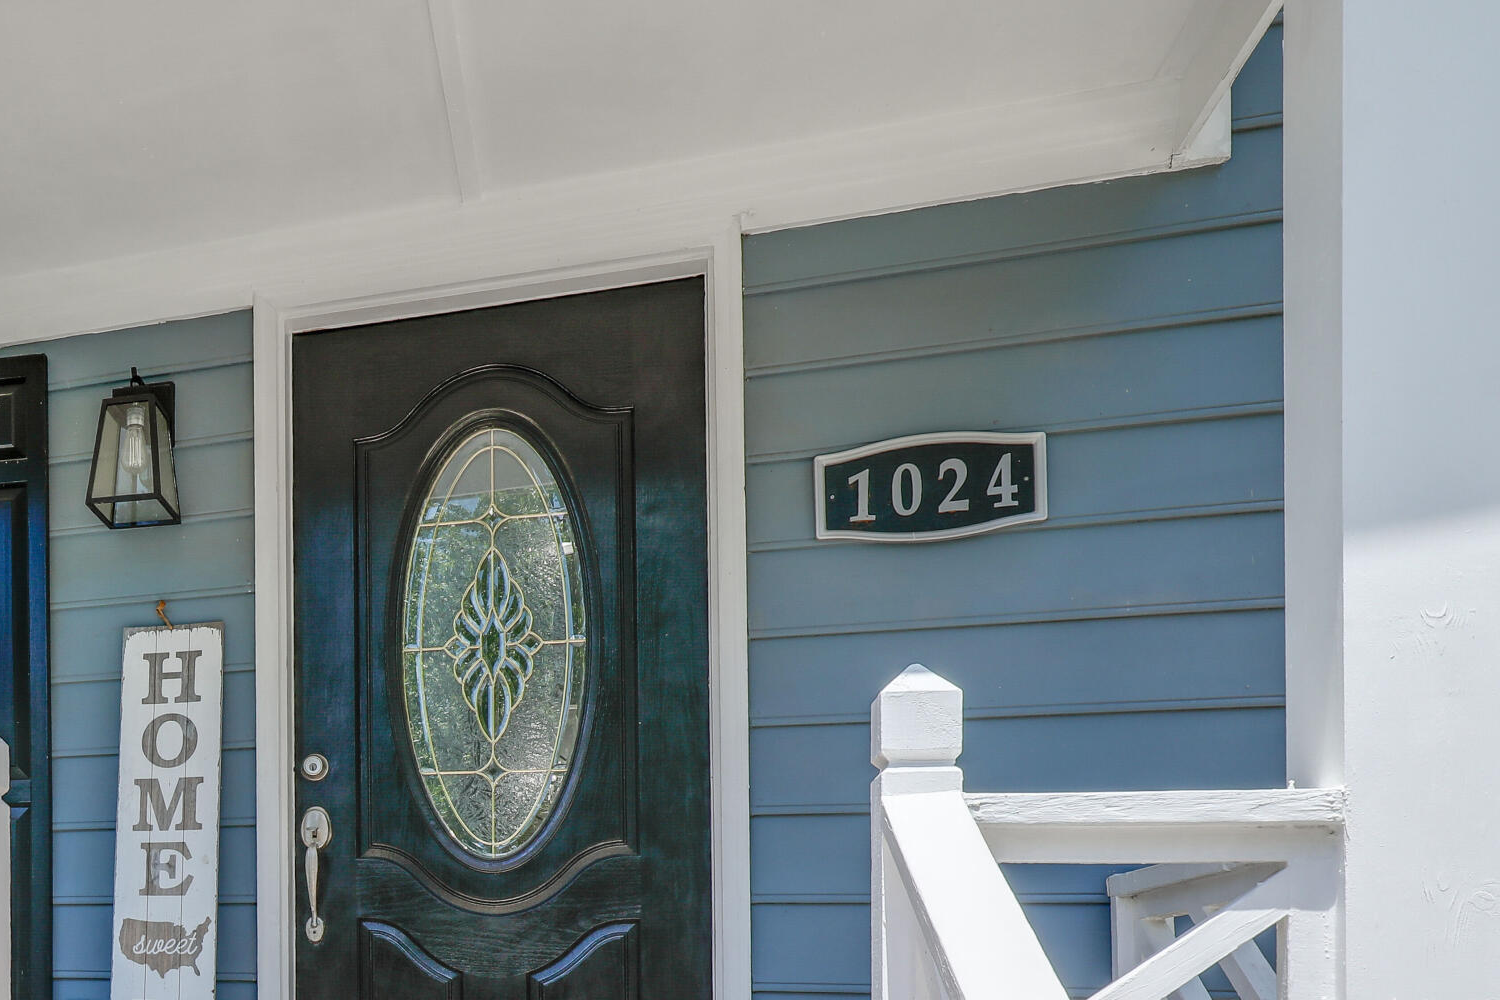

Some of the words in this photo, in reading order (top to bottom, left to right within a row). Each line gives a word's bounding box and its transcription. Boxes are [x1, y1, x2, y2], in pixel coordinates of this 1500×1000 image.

[847, 452, 1019, 522] 1024
[132, 649, 205, 896] HOME
[133, 932, 198, 955] sweet
